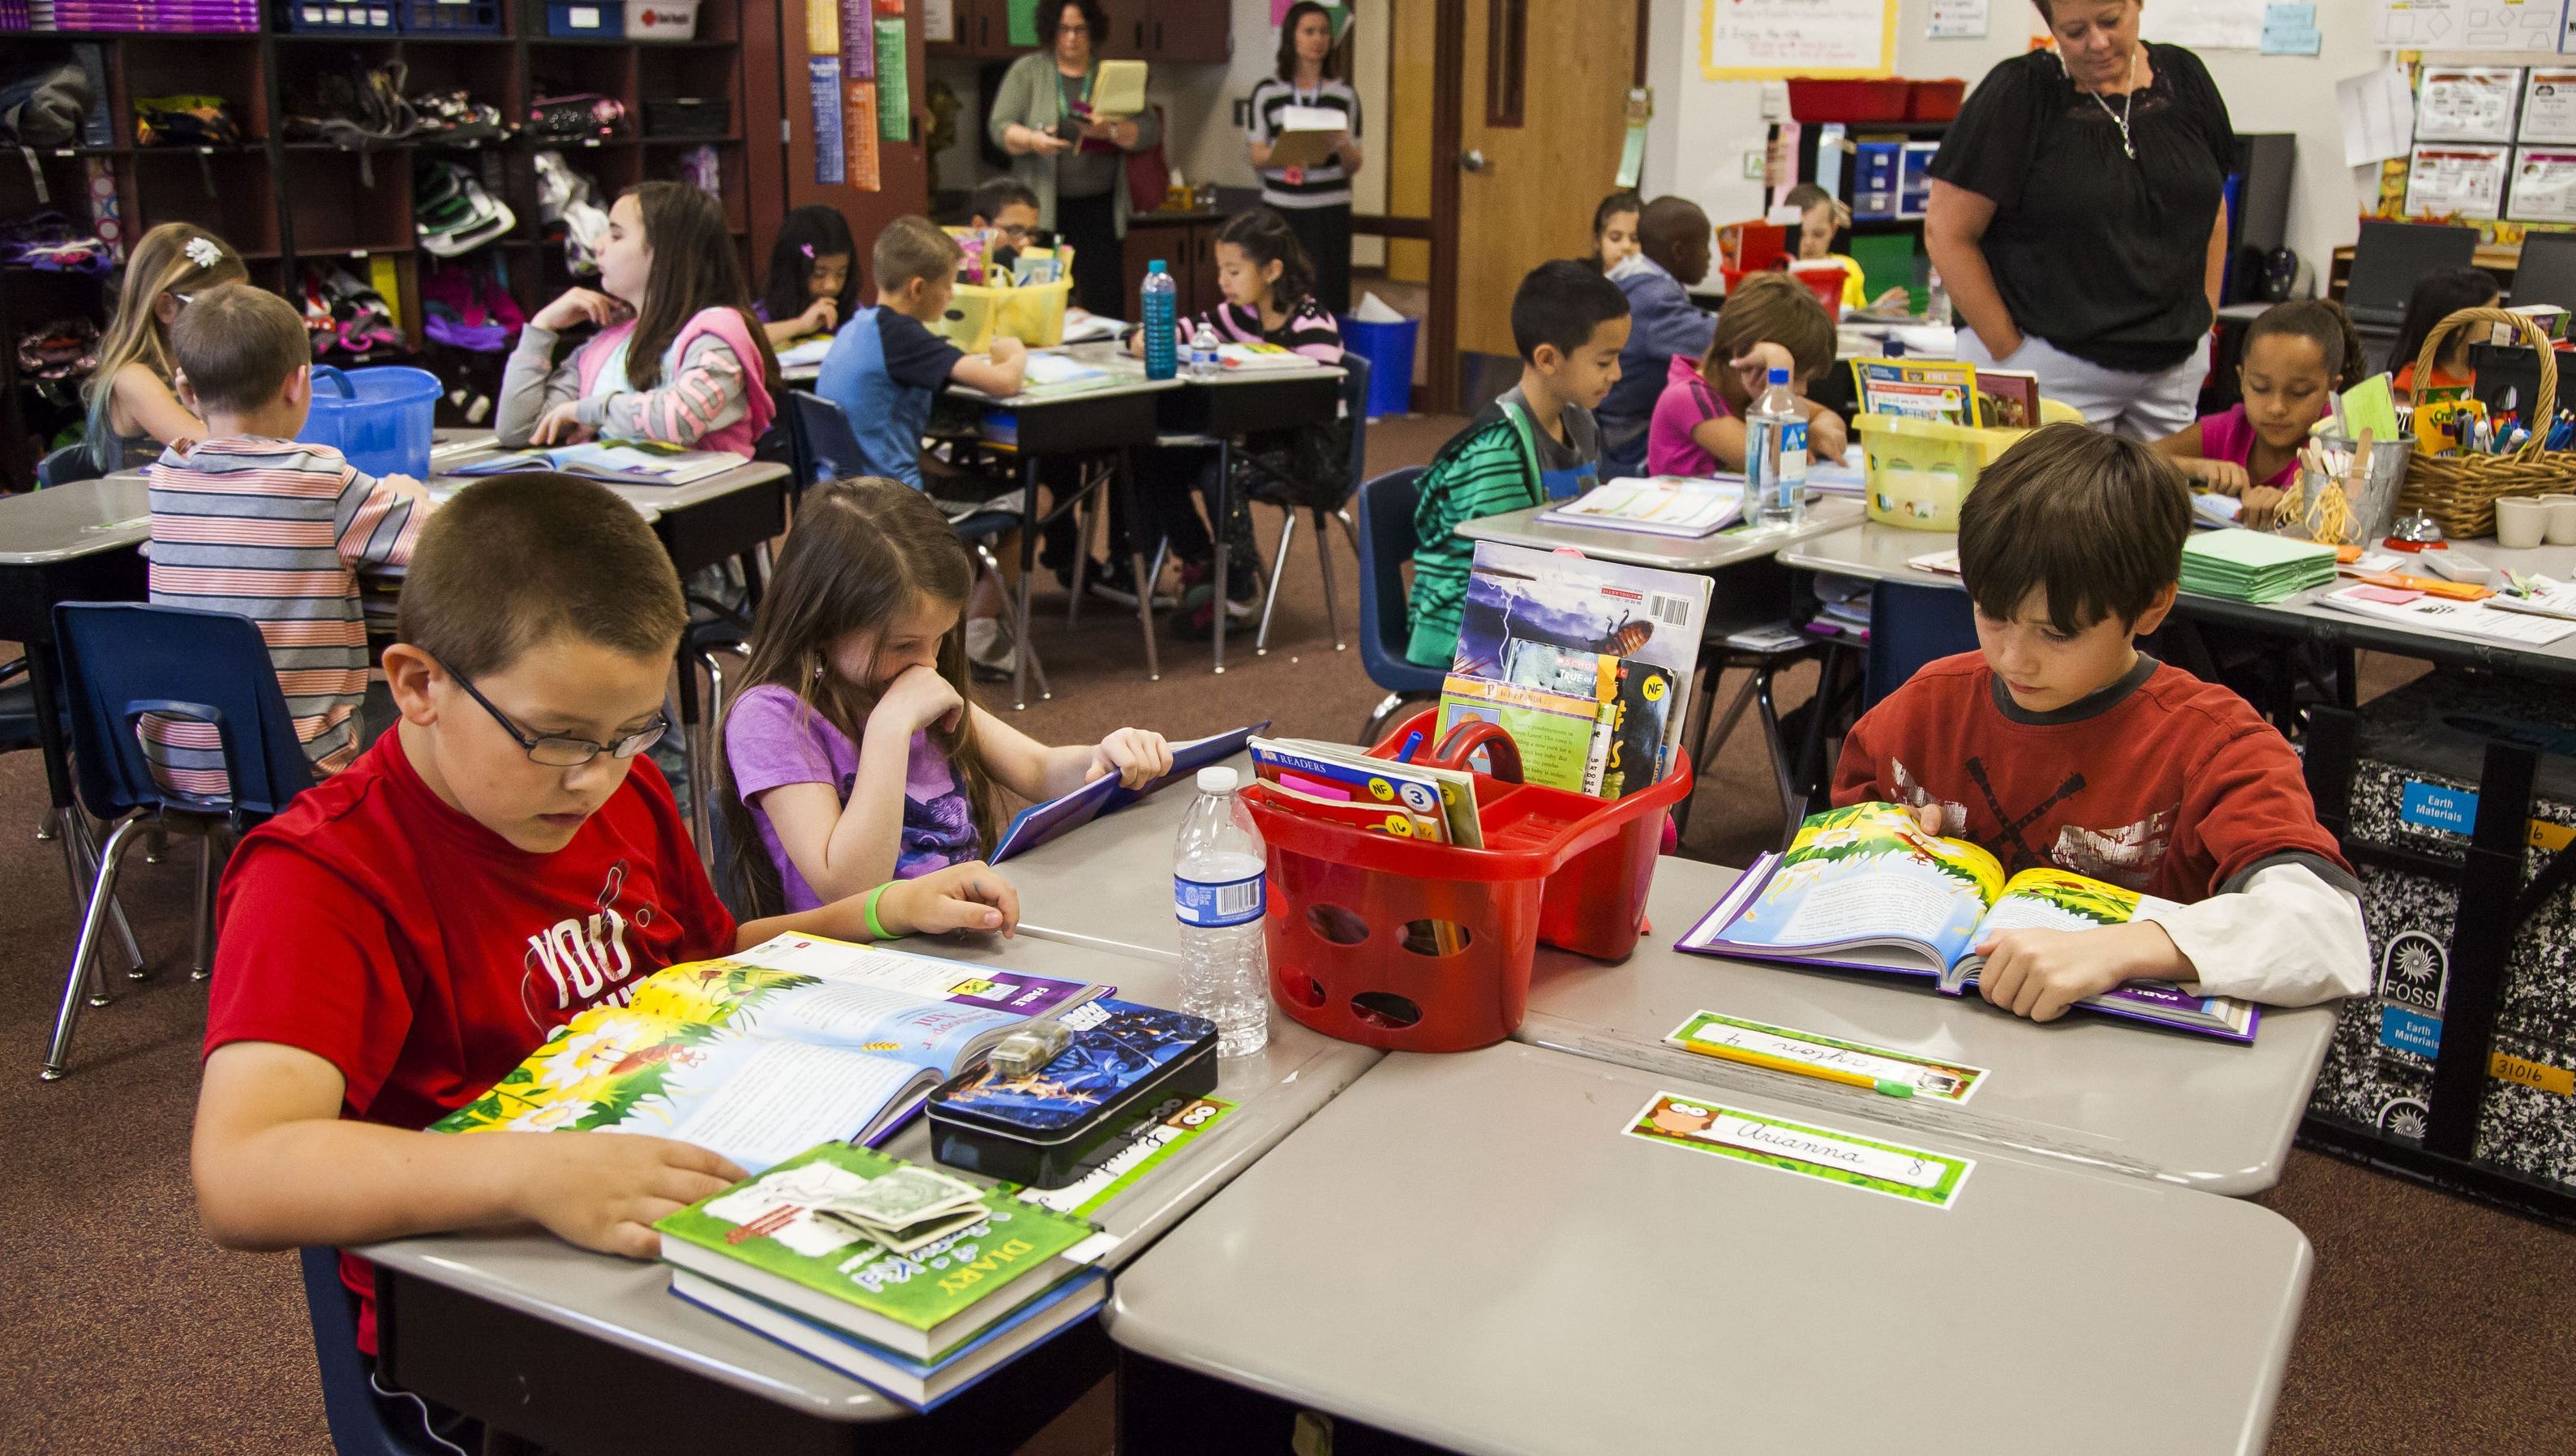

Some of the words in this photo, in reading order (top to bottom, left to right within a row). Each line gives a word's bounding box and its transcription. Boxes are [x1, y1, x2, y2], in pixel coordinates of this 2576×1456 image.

[1601, 588, 1638, 599] SCHOLASTIC
[1560, 668, 1583, 684] TRUE
[1487, 683, 1496, 696] P
[1646, 683, 1663, 694] NF
[1281, 756, 1327, 773] READERS
[1373, 784, 1389, 795] NF
[1410, 790, 1424, 805] 3
[2428, 795, 2454, 809] Earth
[2415, 804, 2462, 822] Materials
[1393, 822, 1406, 833] 16
[527, 908, 632, 1010] YOU
[1010, 986, 1050, 1007] FABLE
[2121, 987, 2178, 1001] FABLE
[2384, 979, 2436, 1008] FOSS
[2406, 1021, 2431, 1036] Earth
[1724, 1033, 1741, 1046] 4
[2394, 1029, 2440, 1050] Materials
[2496, 1059, 2544, 1082] 31016
[1737, 1121, 1864, 1163] Arianna
[1907, 1157, 1926, 1176] 8
[938, 1238, 1037, 1297] DIARY
